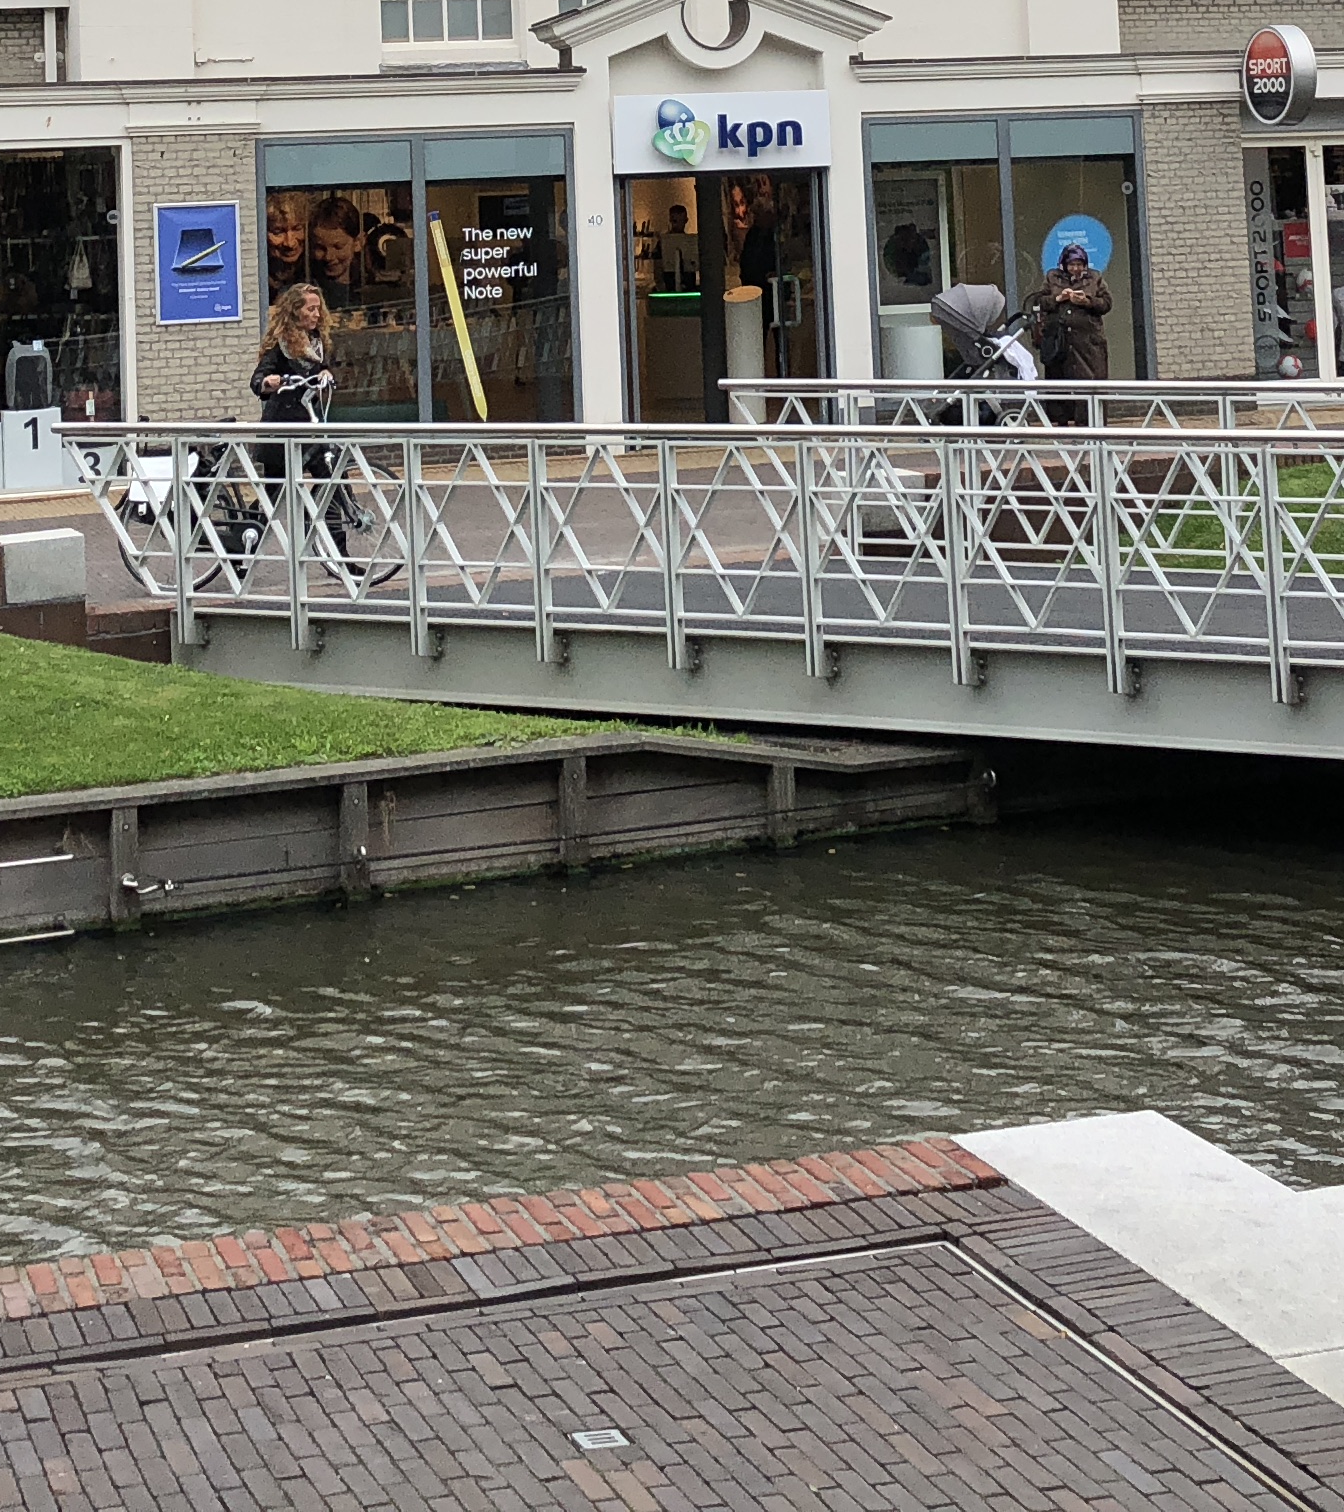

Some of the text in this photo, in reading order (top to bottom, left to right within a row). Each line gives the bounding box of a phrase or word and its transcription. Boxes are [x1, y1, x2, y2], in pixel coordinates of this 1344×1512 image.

[1249, 57, 1288, 75] SPORT
[1253, 76, 1286, 94] 2000
[717, 113, 804, 158] kpn
[462, 226, 534, 242] The new
[462, 246, 510, 263] super
[463, 262, 538, 284] powerful
[464, 285, 503, 300] Note
[23, 416, 39, 450] 1
